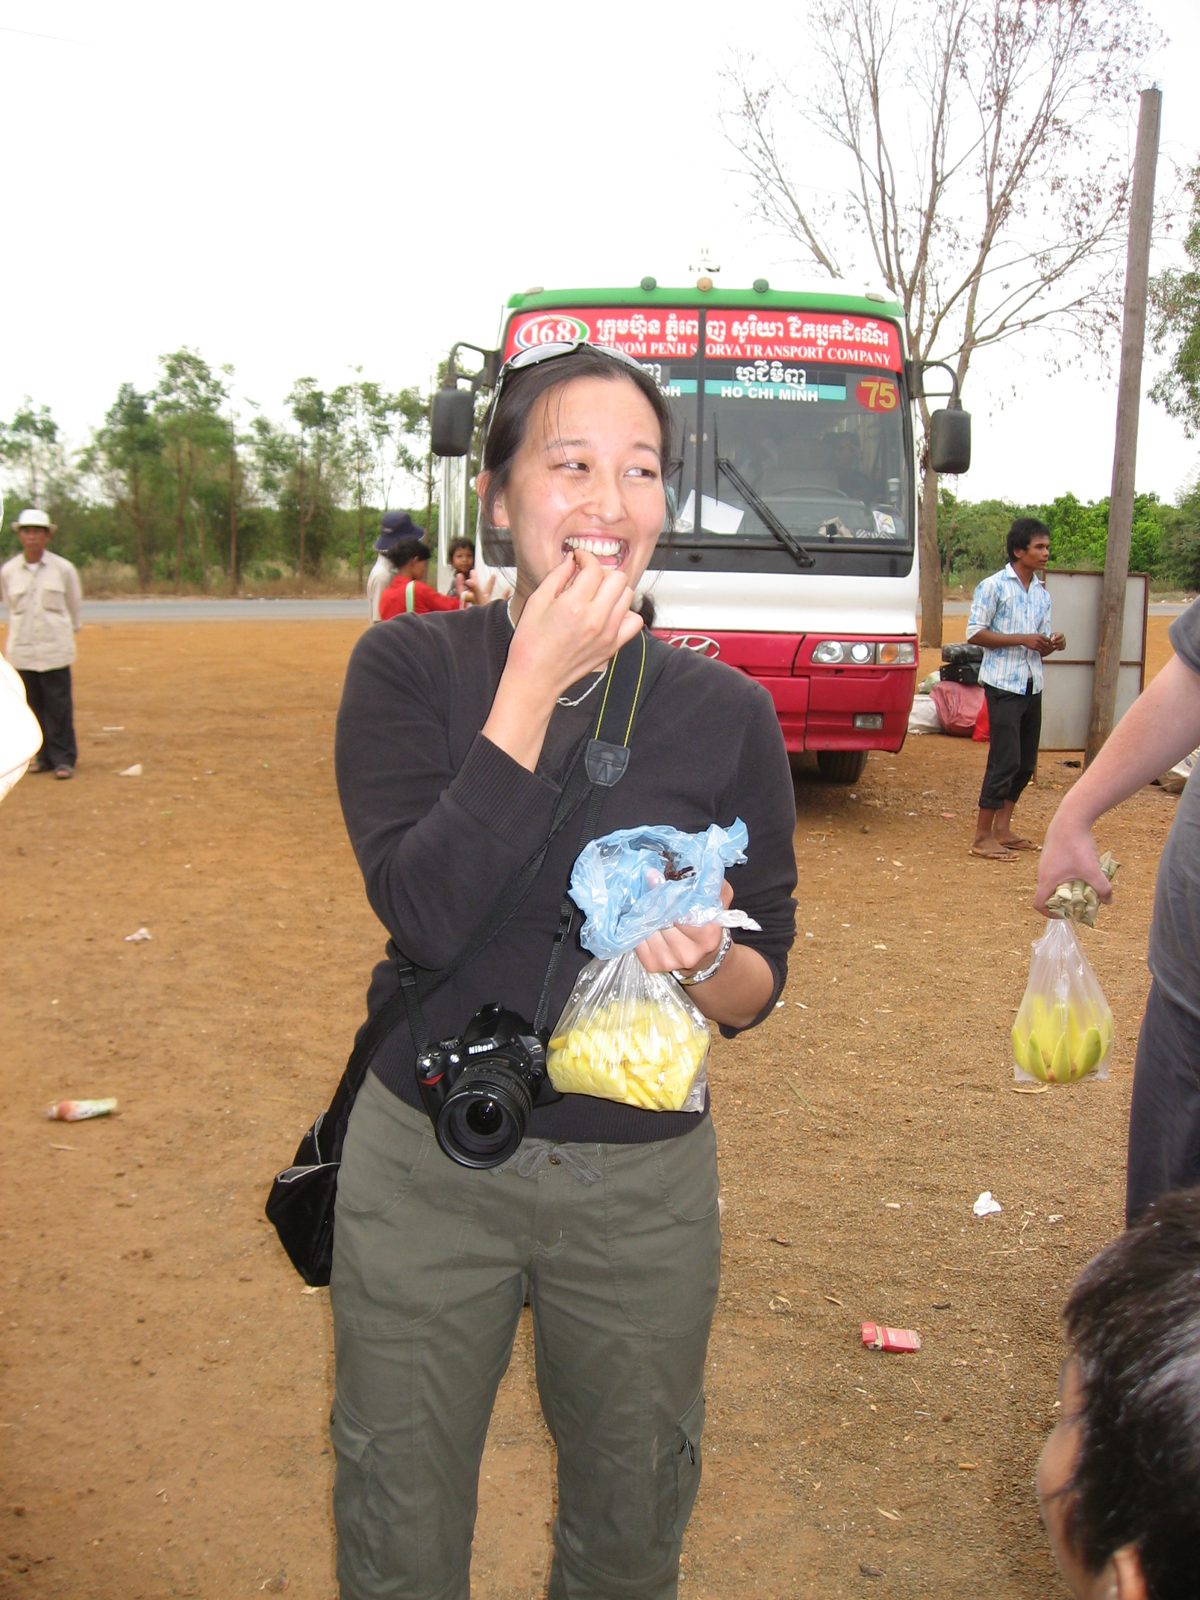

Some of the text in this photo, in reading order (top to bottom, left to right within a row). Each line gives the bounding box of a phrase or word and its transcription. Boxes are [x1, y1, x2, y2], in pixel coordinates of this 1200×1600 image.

[530, 320, 573, 344] 168
[650, 342, 687, 355] PENH
[744, 344, 825, 360] TRANSPORT
[827, 347, 891, 367] COMPANY
[721, 386, 819, 402] HO CHI MINH
[860, 380, 898, 410] 75
[468, 1043, 494, 1055] Nikon
